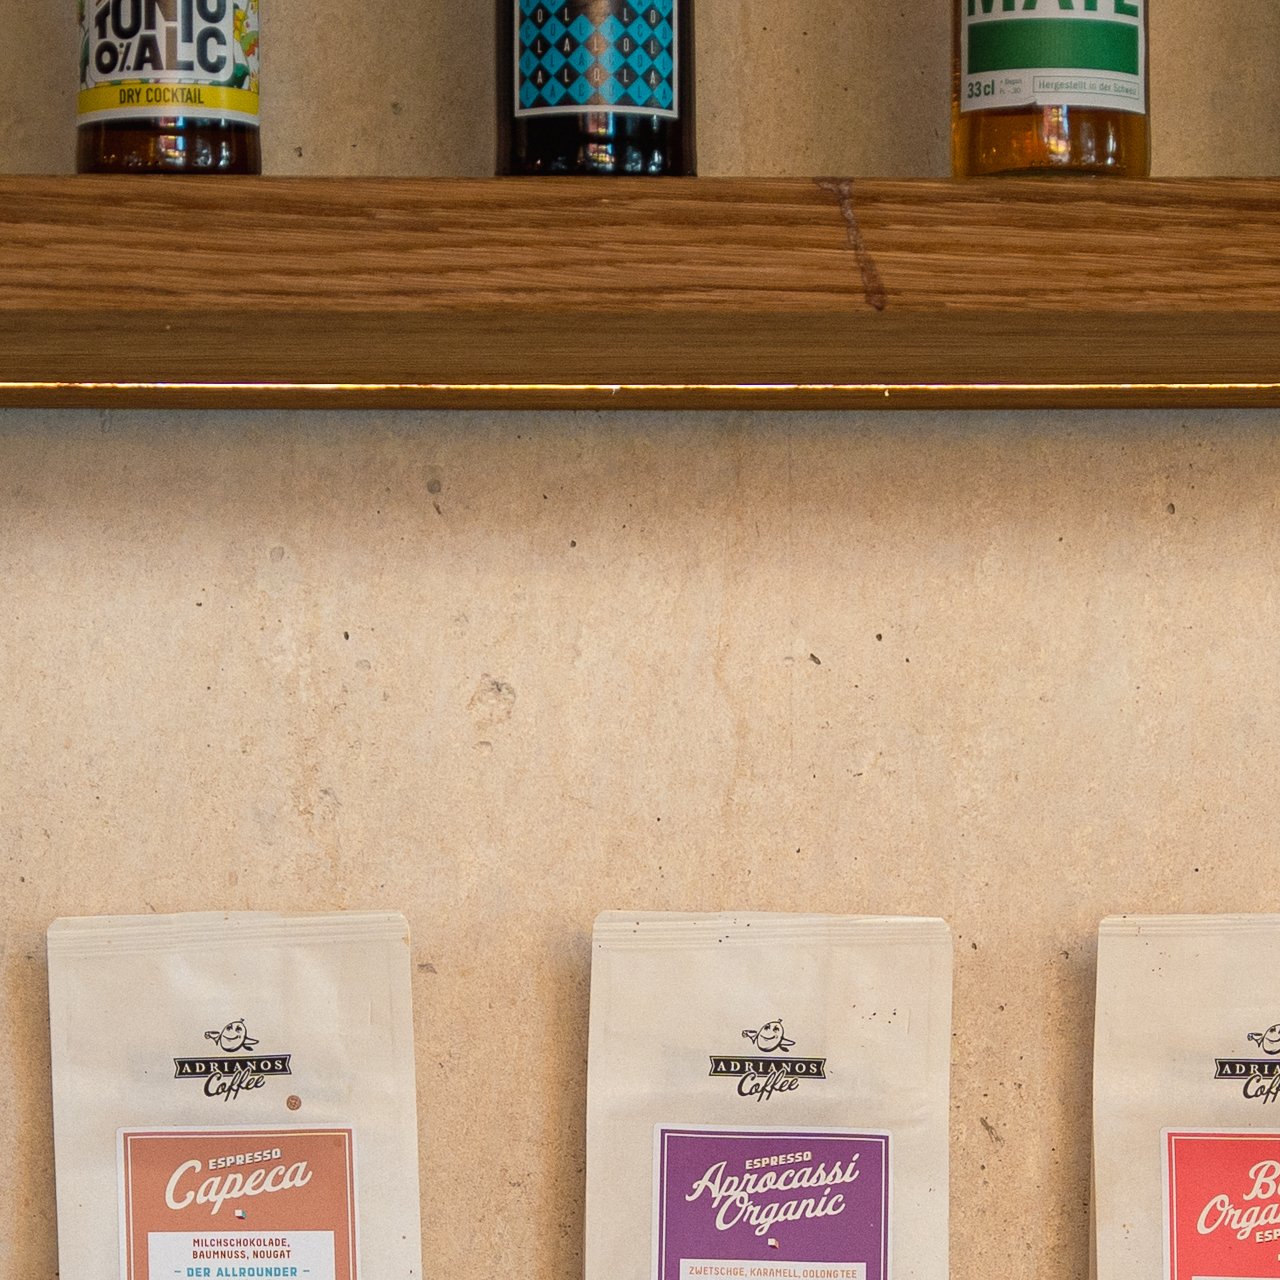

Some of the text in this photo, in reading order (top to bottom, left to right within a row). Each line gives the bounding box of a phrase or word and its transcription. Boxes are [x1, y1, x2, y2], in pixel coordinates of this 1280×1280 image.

[1100, 81, 1111, 91] der
[119, 88, 204, 104] DRY COCKTAIL
[182, 1060, 283, 1073] ADRIANOS
[717, 1061, 818, 1073] ADRIANOS
[204, 1068, 266, 1102] Coffee
[737, 1068, 799, 1102] Coffee
[208, 1148, 282, 1171] ESPRESSO
[746, 1151, 812, 1169] ESPRESSO
[165, 1160, 312, 1216] Capeca
[685, 1153, 860, 1208] Aprocassi
[715, 1188, 845, 1236] Organic
[193, 1238, 290, 1248] MILCHSCHOKOLADE,
[192, 1250, 291, 1260] BAUMNUSS, NOUGAT
[187, 1267, 298, 1277] DER ALLROUNDER
[689, 1266, 857, 1279] ZWETSCHGE, KARAMELL, OOLONG TEE
